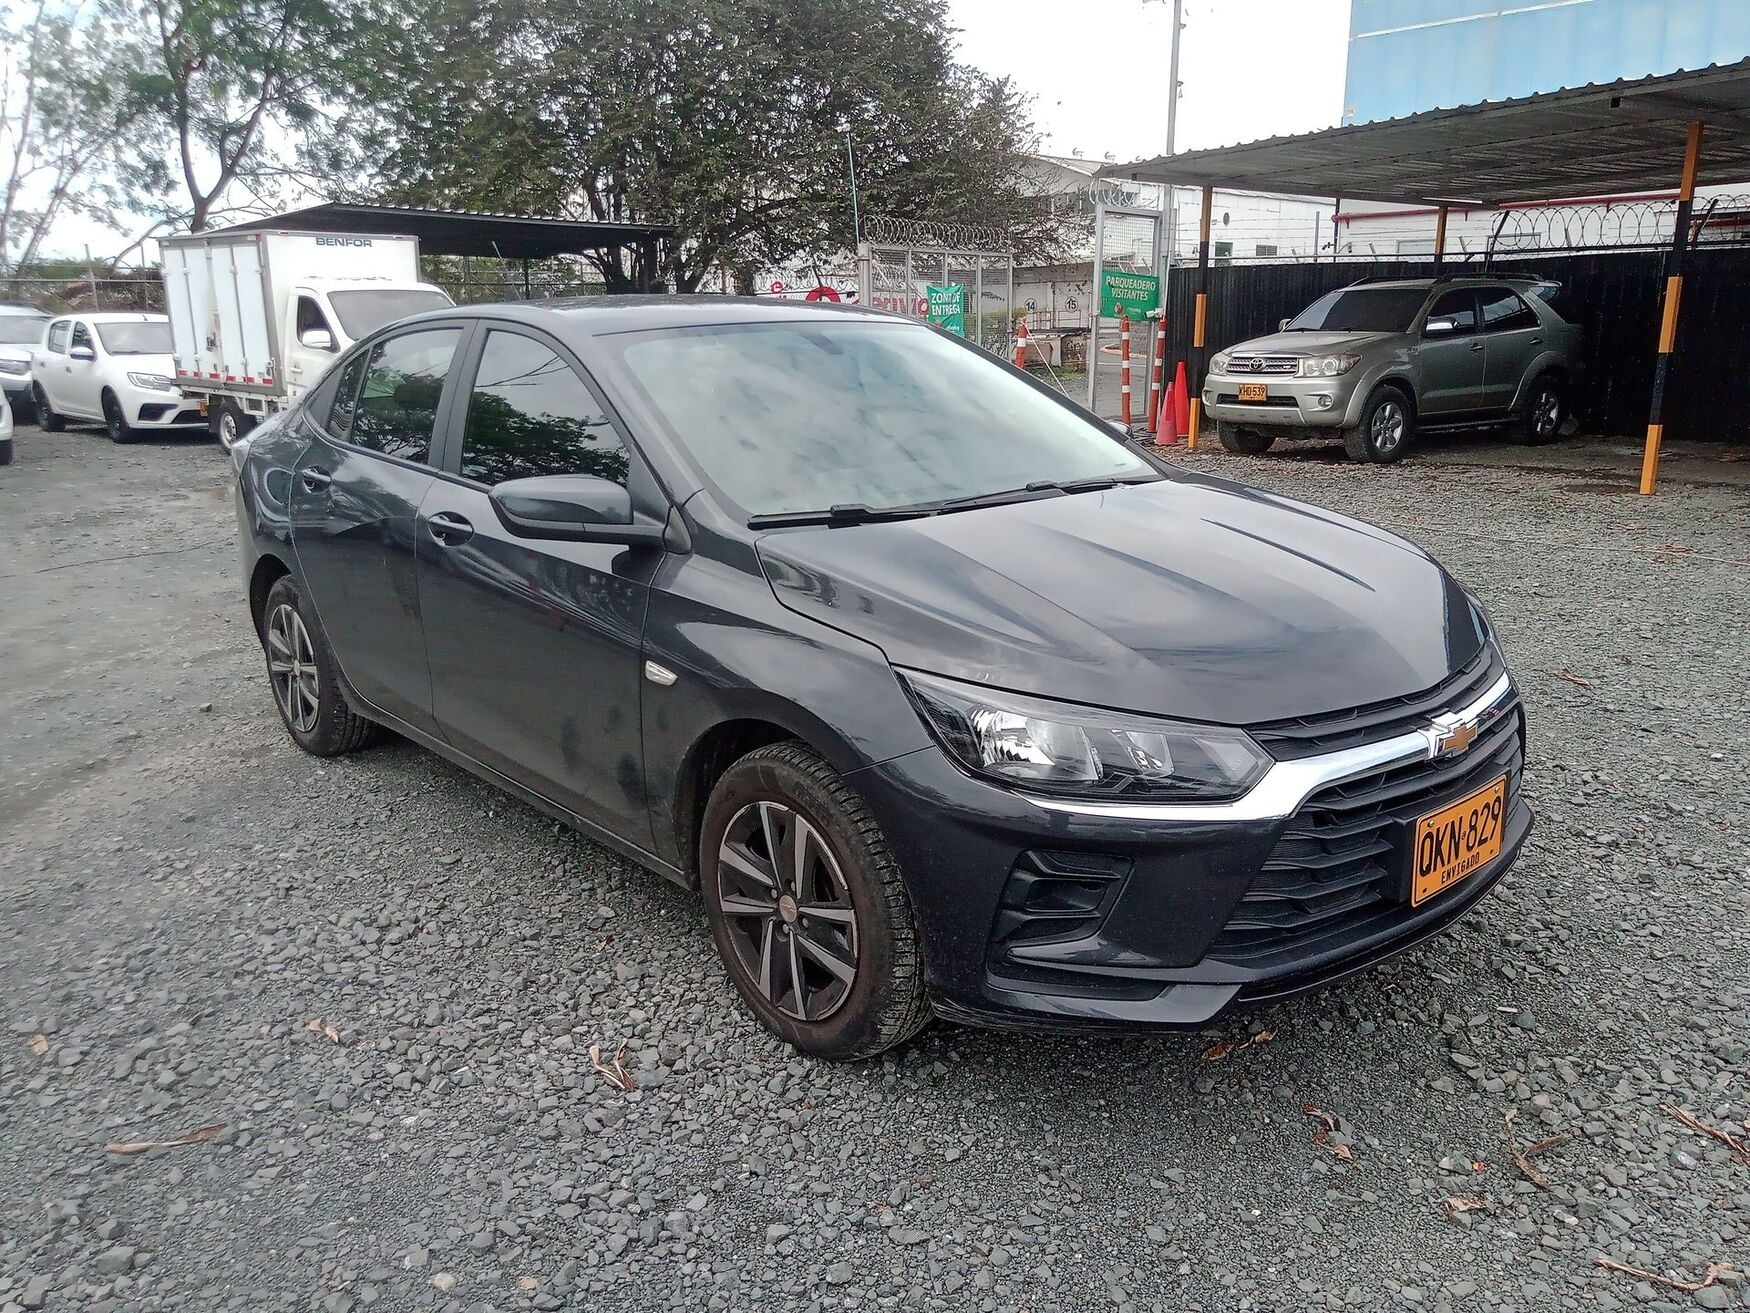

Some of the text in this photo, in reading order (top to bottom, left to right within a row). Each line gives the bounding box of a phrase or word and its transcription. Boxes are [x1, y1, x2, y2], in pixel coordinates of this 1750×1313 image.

[316, 237, 372, 247] BENFOR
[1106, 275, 1156, 291] PARQUEADERO
[1111, 287, 1149, 301] VISITANTES
[931, 303, 961, 316] ENTREGA
[1025, 301, 1035, 312] 14
[1066, 298, 1077, 310] 15
[1441, 851, 1480, 884] ENVIGADO
